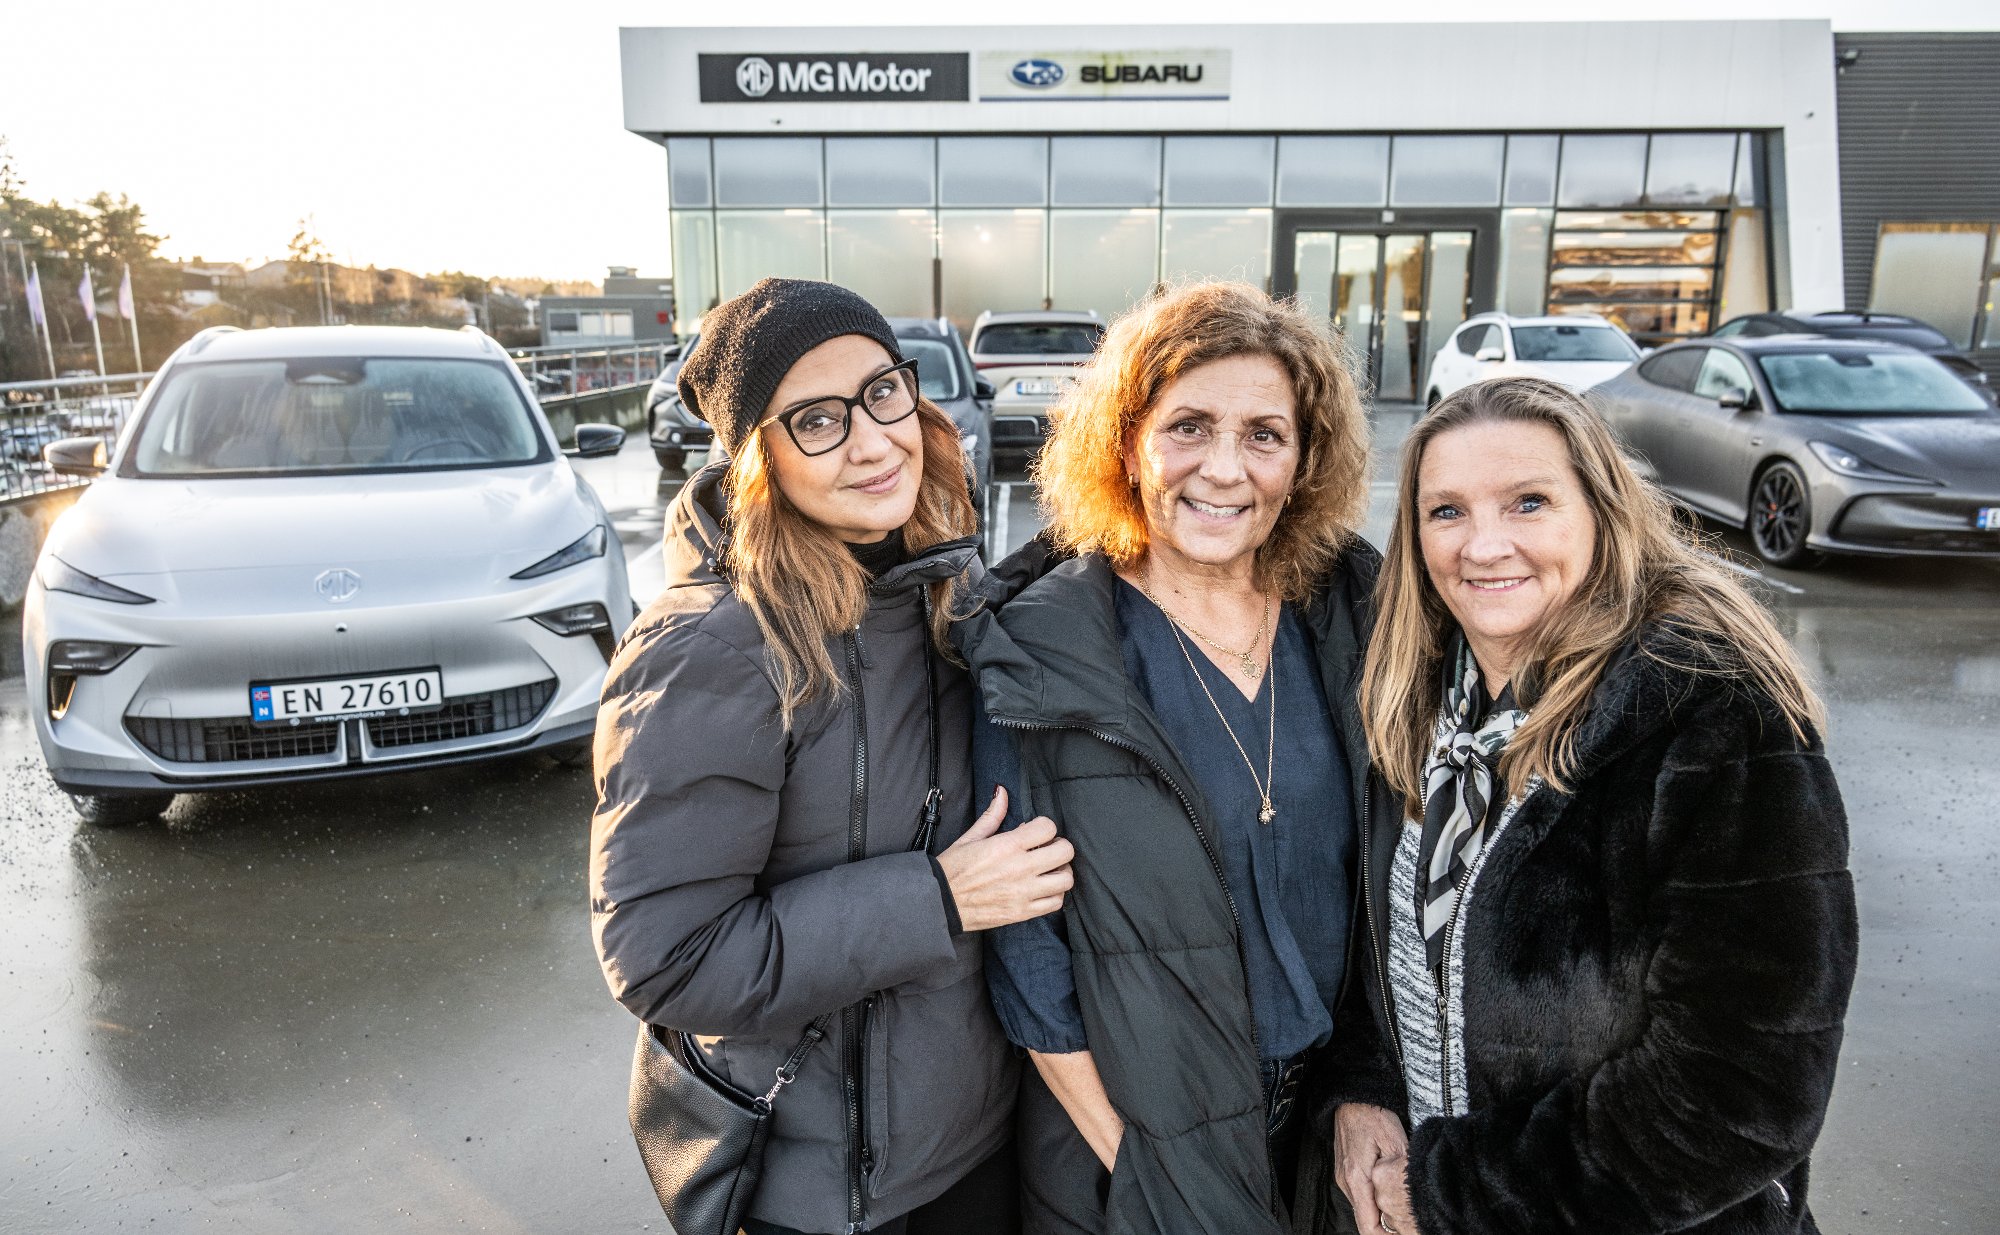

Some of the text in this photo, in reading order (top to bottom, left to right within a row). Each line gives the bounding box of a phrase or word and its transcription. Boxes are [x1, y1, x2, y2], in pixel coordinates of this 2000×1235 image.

[777, 61, 834, 92] MG
[837, 61, 932, 92] Motor
[1080, 64, 1203, 83] SUBARU
[282, 678, 431, 714] EN 27610
[258, 707, 269, 716] N
